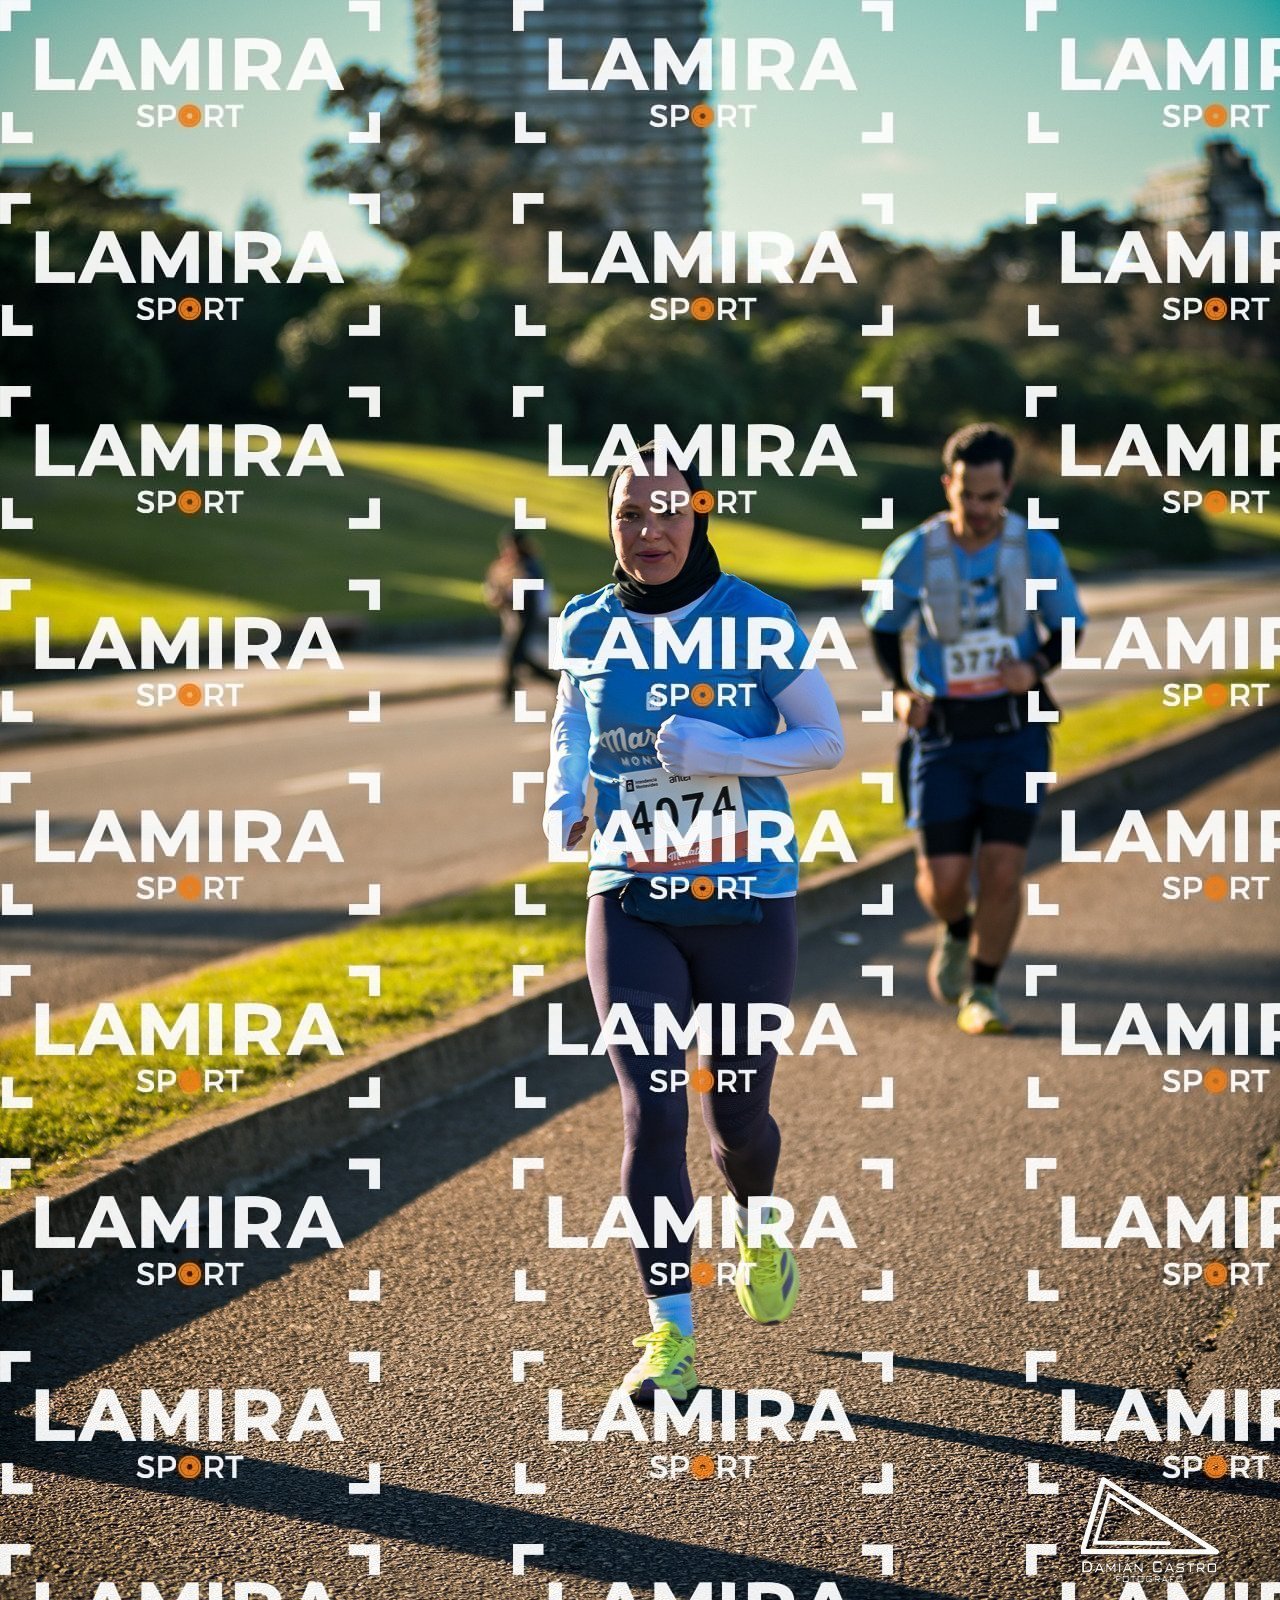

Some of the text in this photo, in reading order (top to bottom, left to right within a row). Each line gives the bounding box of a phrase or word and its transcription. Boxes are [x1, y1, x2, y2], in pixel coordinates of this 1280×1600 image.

[600, 727, 656, 753] Mar
[621, 755, 660, 767] MONT
[632, 785, 737, 835] 4074
